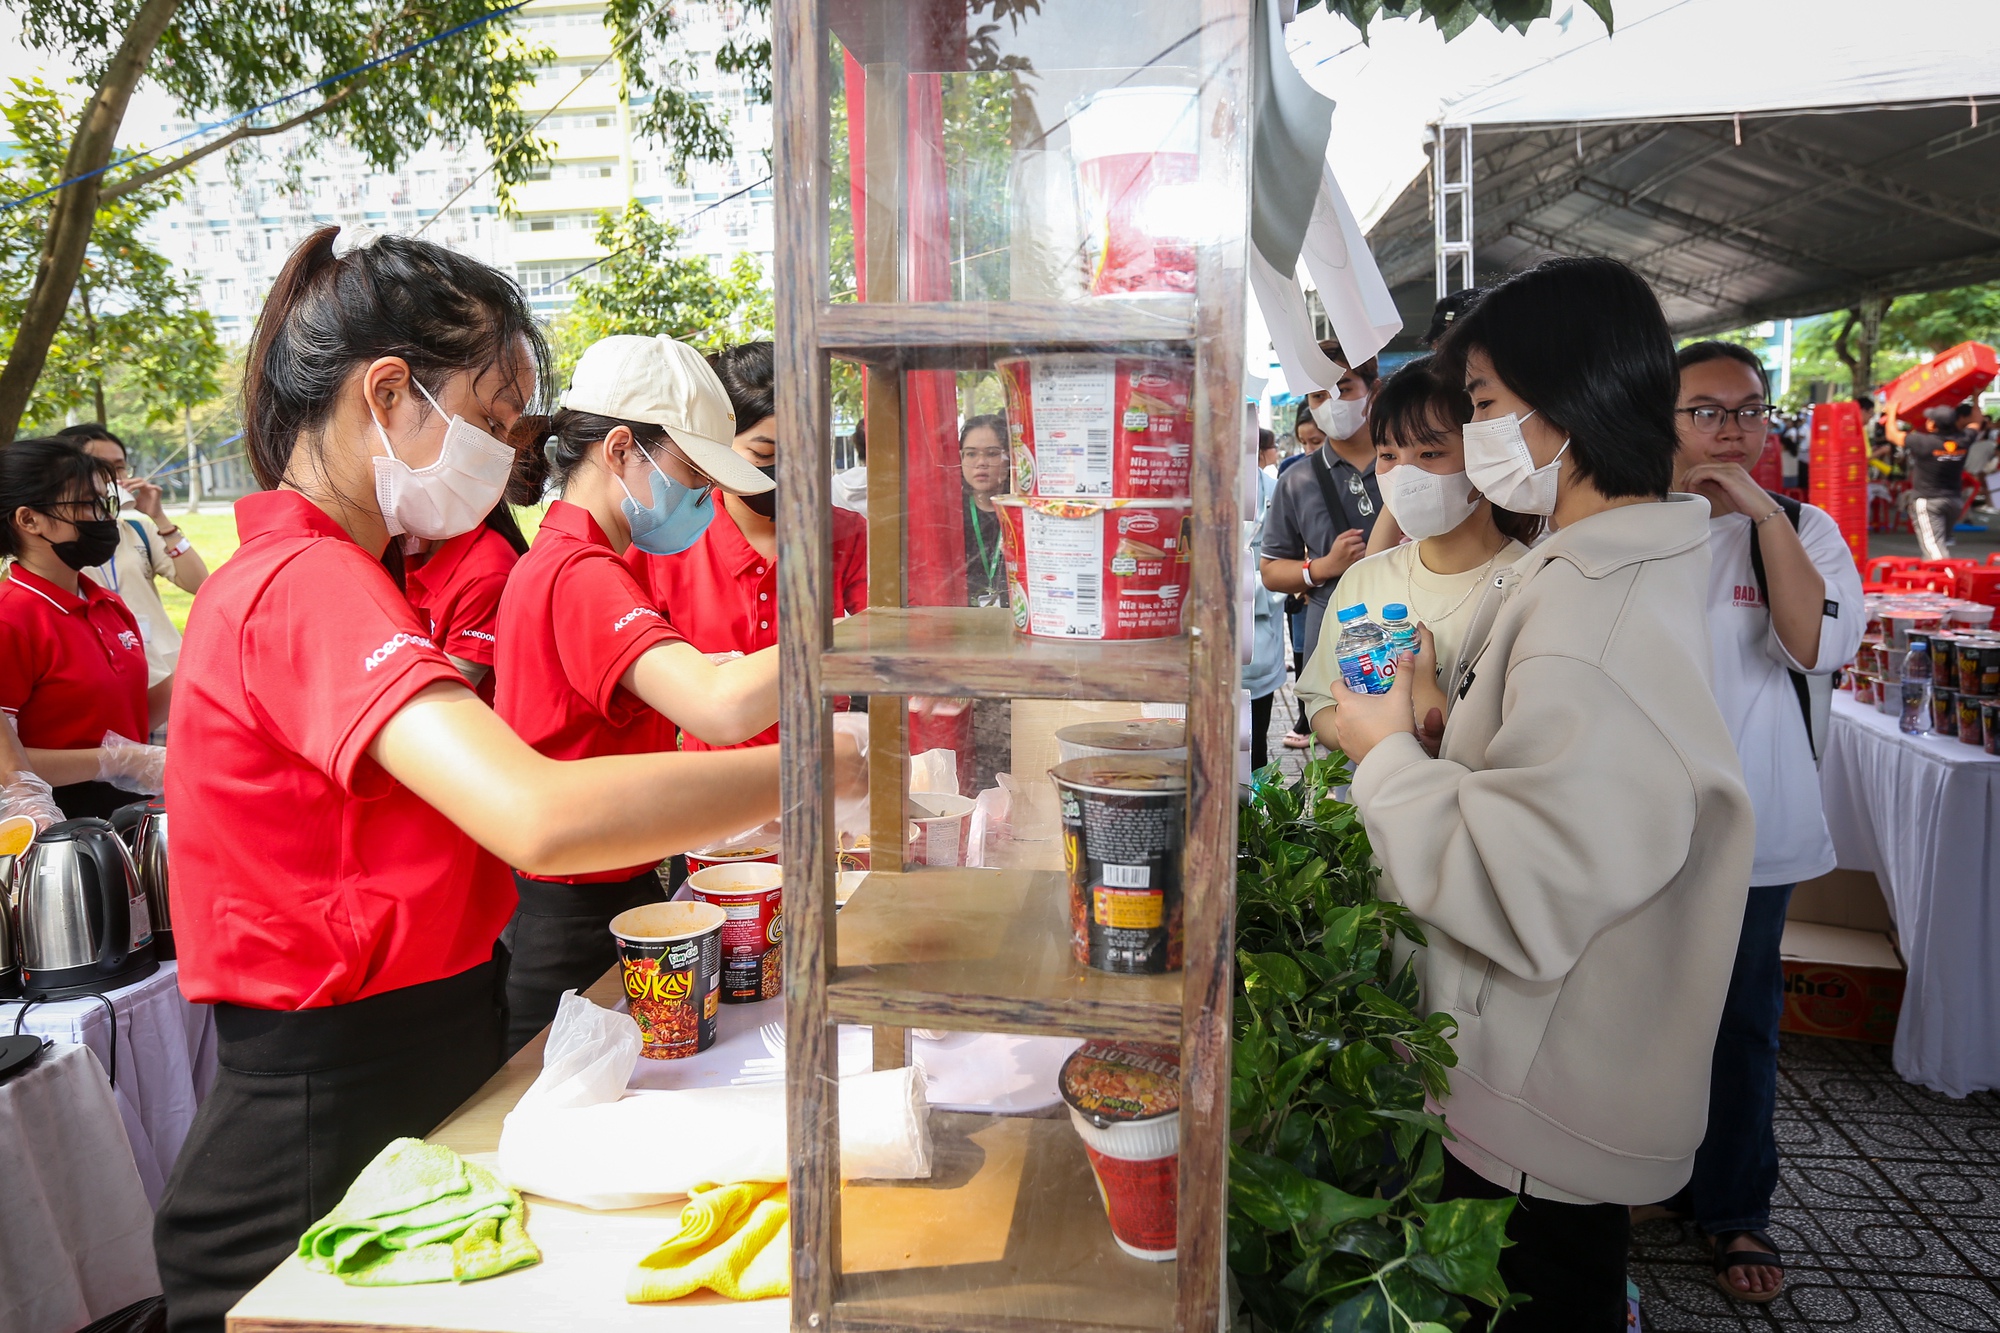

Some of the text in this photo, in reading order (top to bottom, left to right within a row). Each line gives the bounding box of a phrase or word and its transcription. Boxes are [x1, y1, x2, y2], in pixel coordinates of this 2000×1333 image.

[1733, 585, 1755, 602] BAD
[669, 953, 686, 965] Kim
[1120, 1053, 1168, 1074] THÁI
